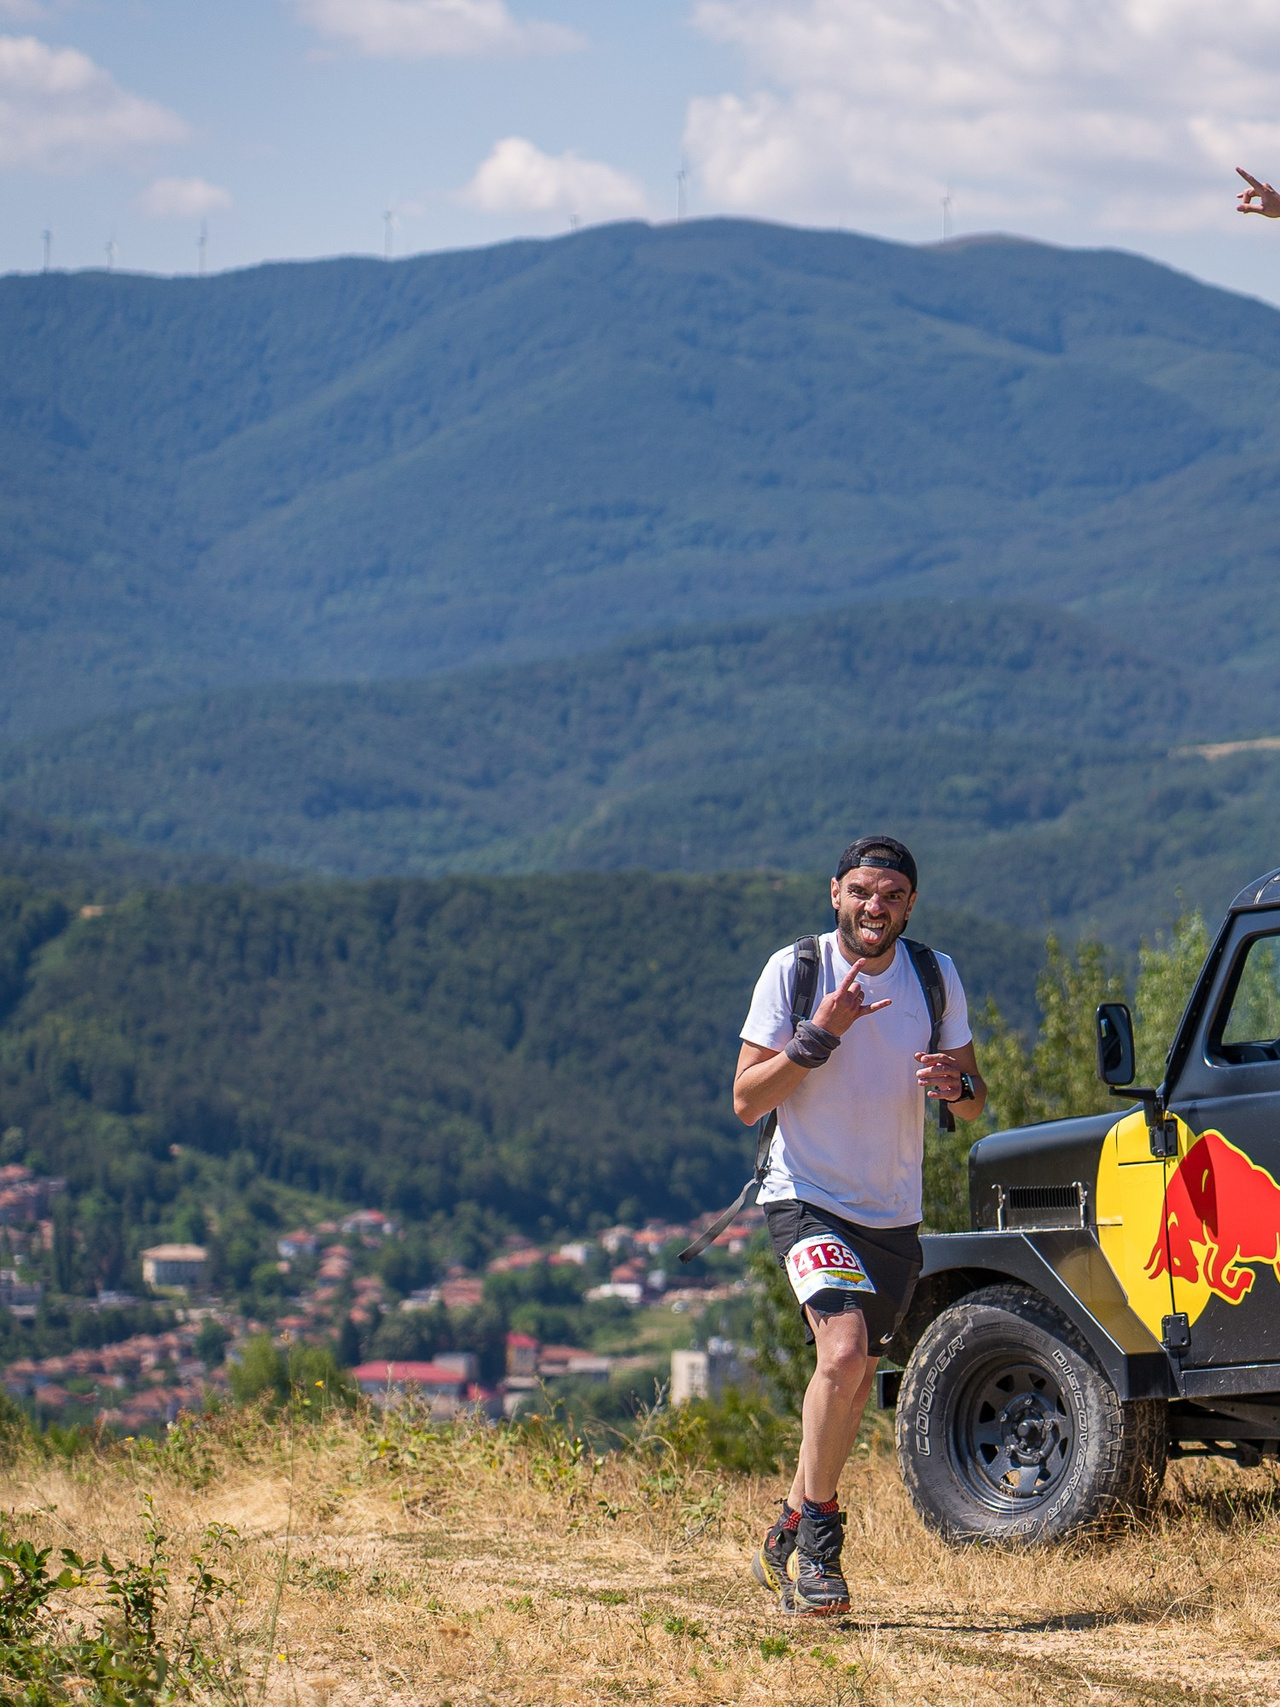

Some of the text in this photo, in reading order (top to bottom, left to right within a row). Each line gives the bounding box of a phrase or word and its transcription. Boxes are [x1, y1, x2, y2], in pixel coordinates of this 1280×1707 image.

[797, 1244, 857, 1273] 4135
[915, 1335, 965, 1456] COOPER
[1047, 1349, 1090, 1521] DISCOVERER
